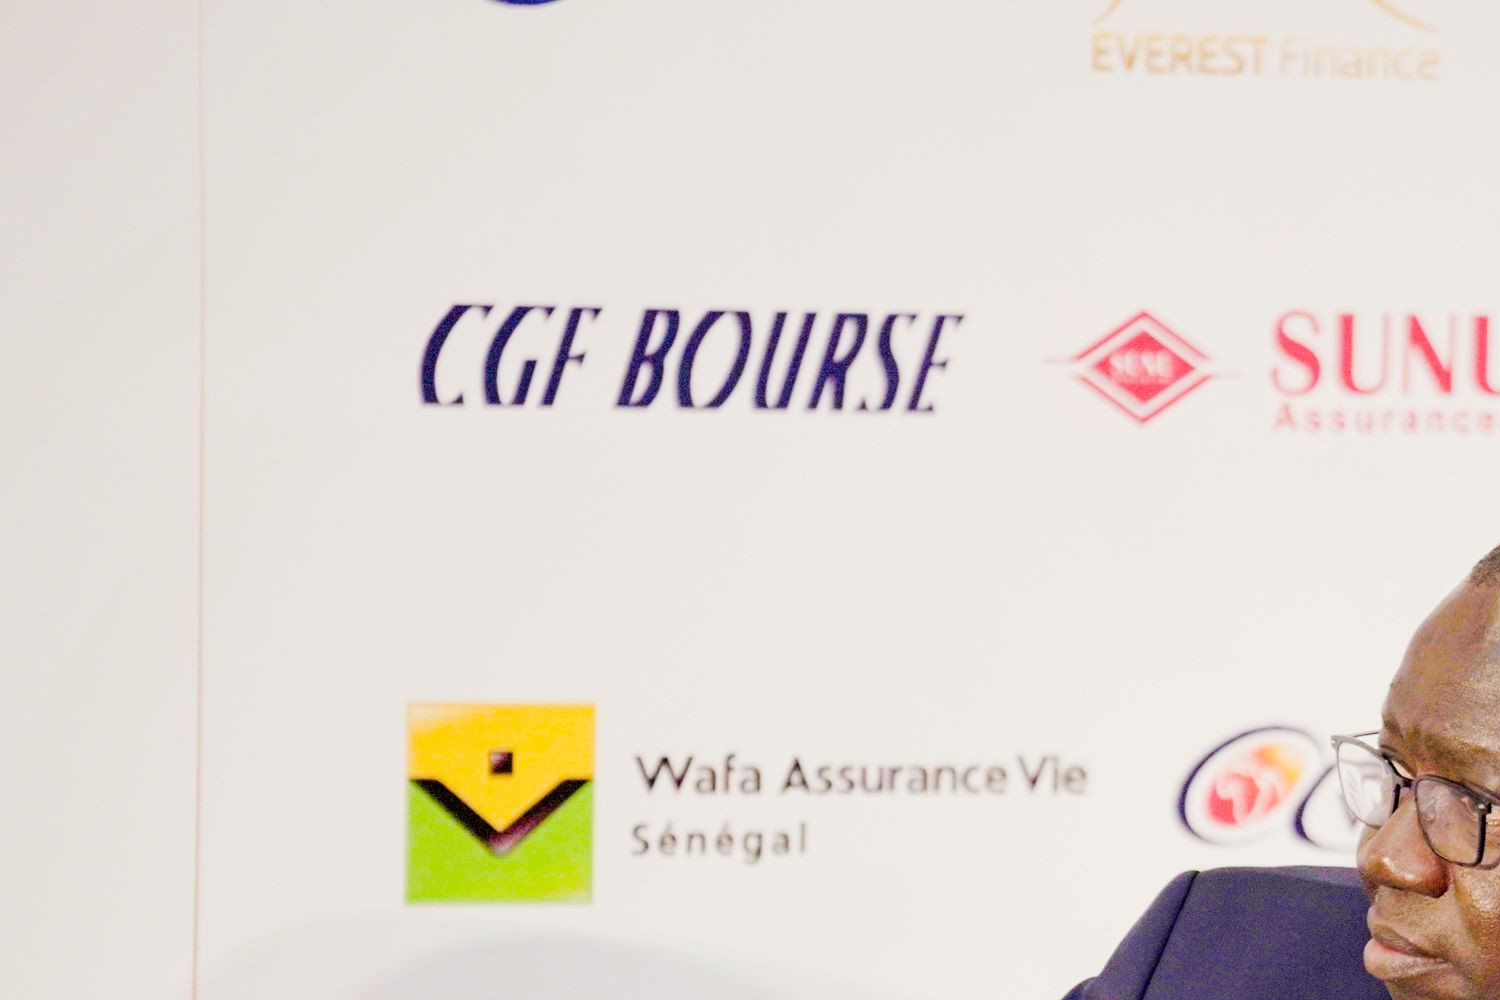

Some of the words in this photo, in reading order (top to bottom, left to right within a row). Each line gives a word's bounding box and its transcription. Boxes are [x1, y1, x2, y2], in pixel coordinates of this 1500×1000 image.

[1091, 30, 1271, 77] EVEREST
[1278, 36, 1443, 81] Finance
[418, 304, 602, 406] CGF
[614, 309, 964, 413] BOURSE
[634, 752, 763, 795] Wafa
[779, 755, 1010, 796] Assurance
[1017, 754, 1090, 796] Vie
[630, 821, 808, 865] Sénégal
